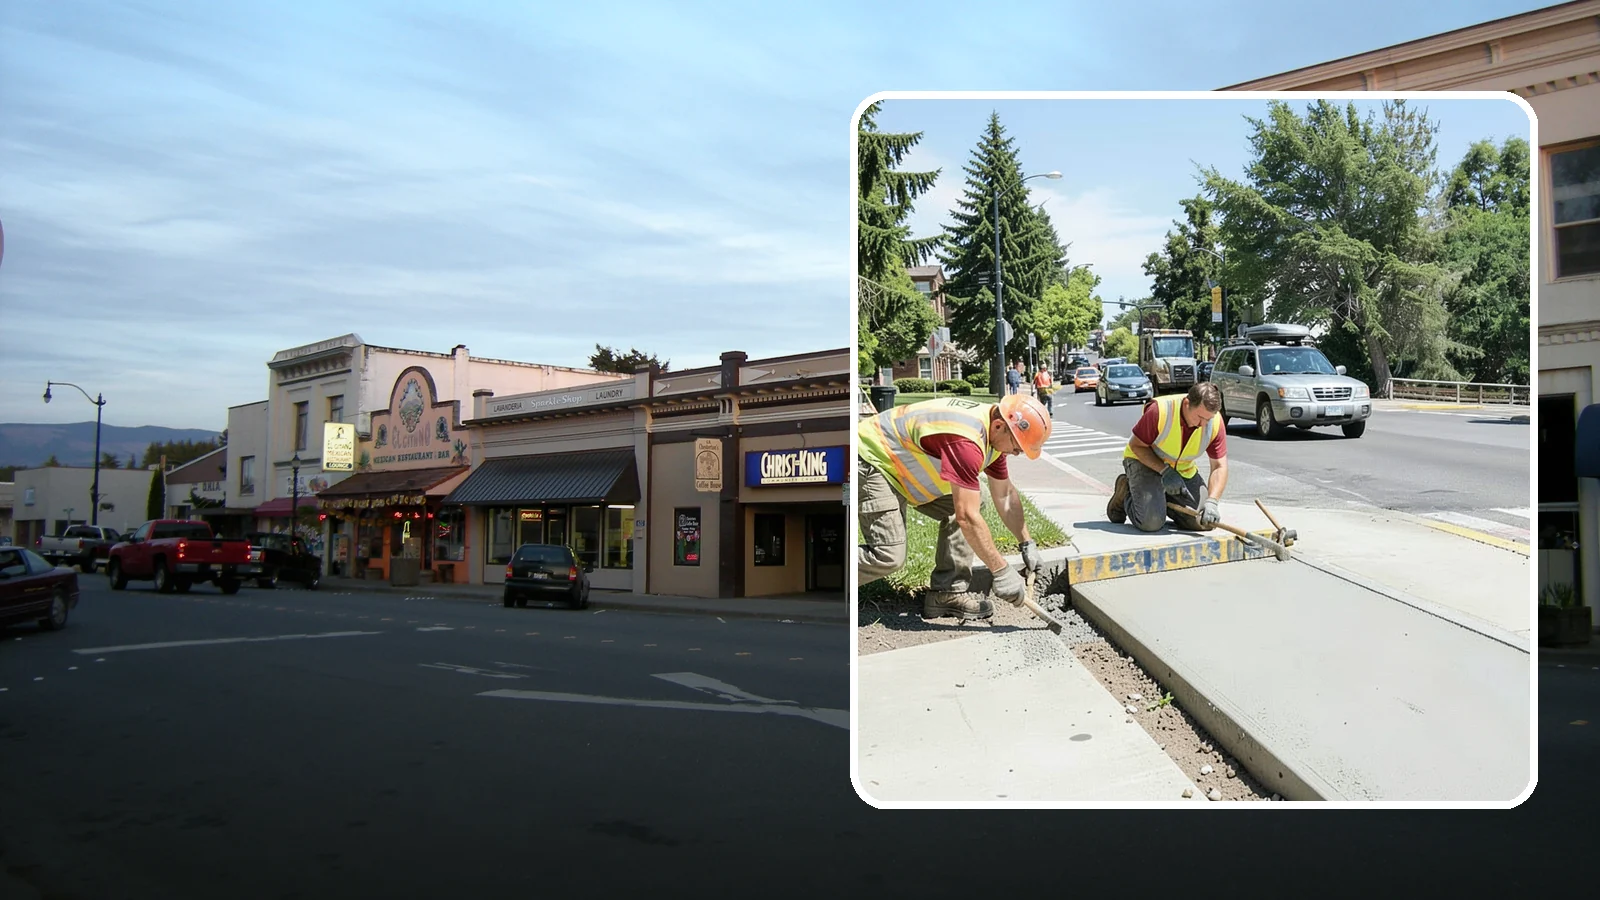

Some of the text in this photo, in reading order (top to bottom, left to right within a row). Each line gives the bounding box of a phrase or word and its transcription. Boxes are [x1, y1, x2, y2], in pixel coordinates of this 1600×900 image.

[595, 389, 624, 400] LAUNDRY
[493, 402, 522, 412] LAVANDERIA
[530, 394, 583, 409] Sparkle Shop
[373, 450, 450, 464] MEXICAN RESTAURANT BAR
[760, 450, 828, 478] CHRIST KING
[697, 480, 722, 489] Coffee House
